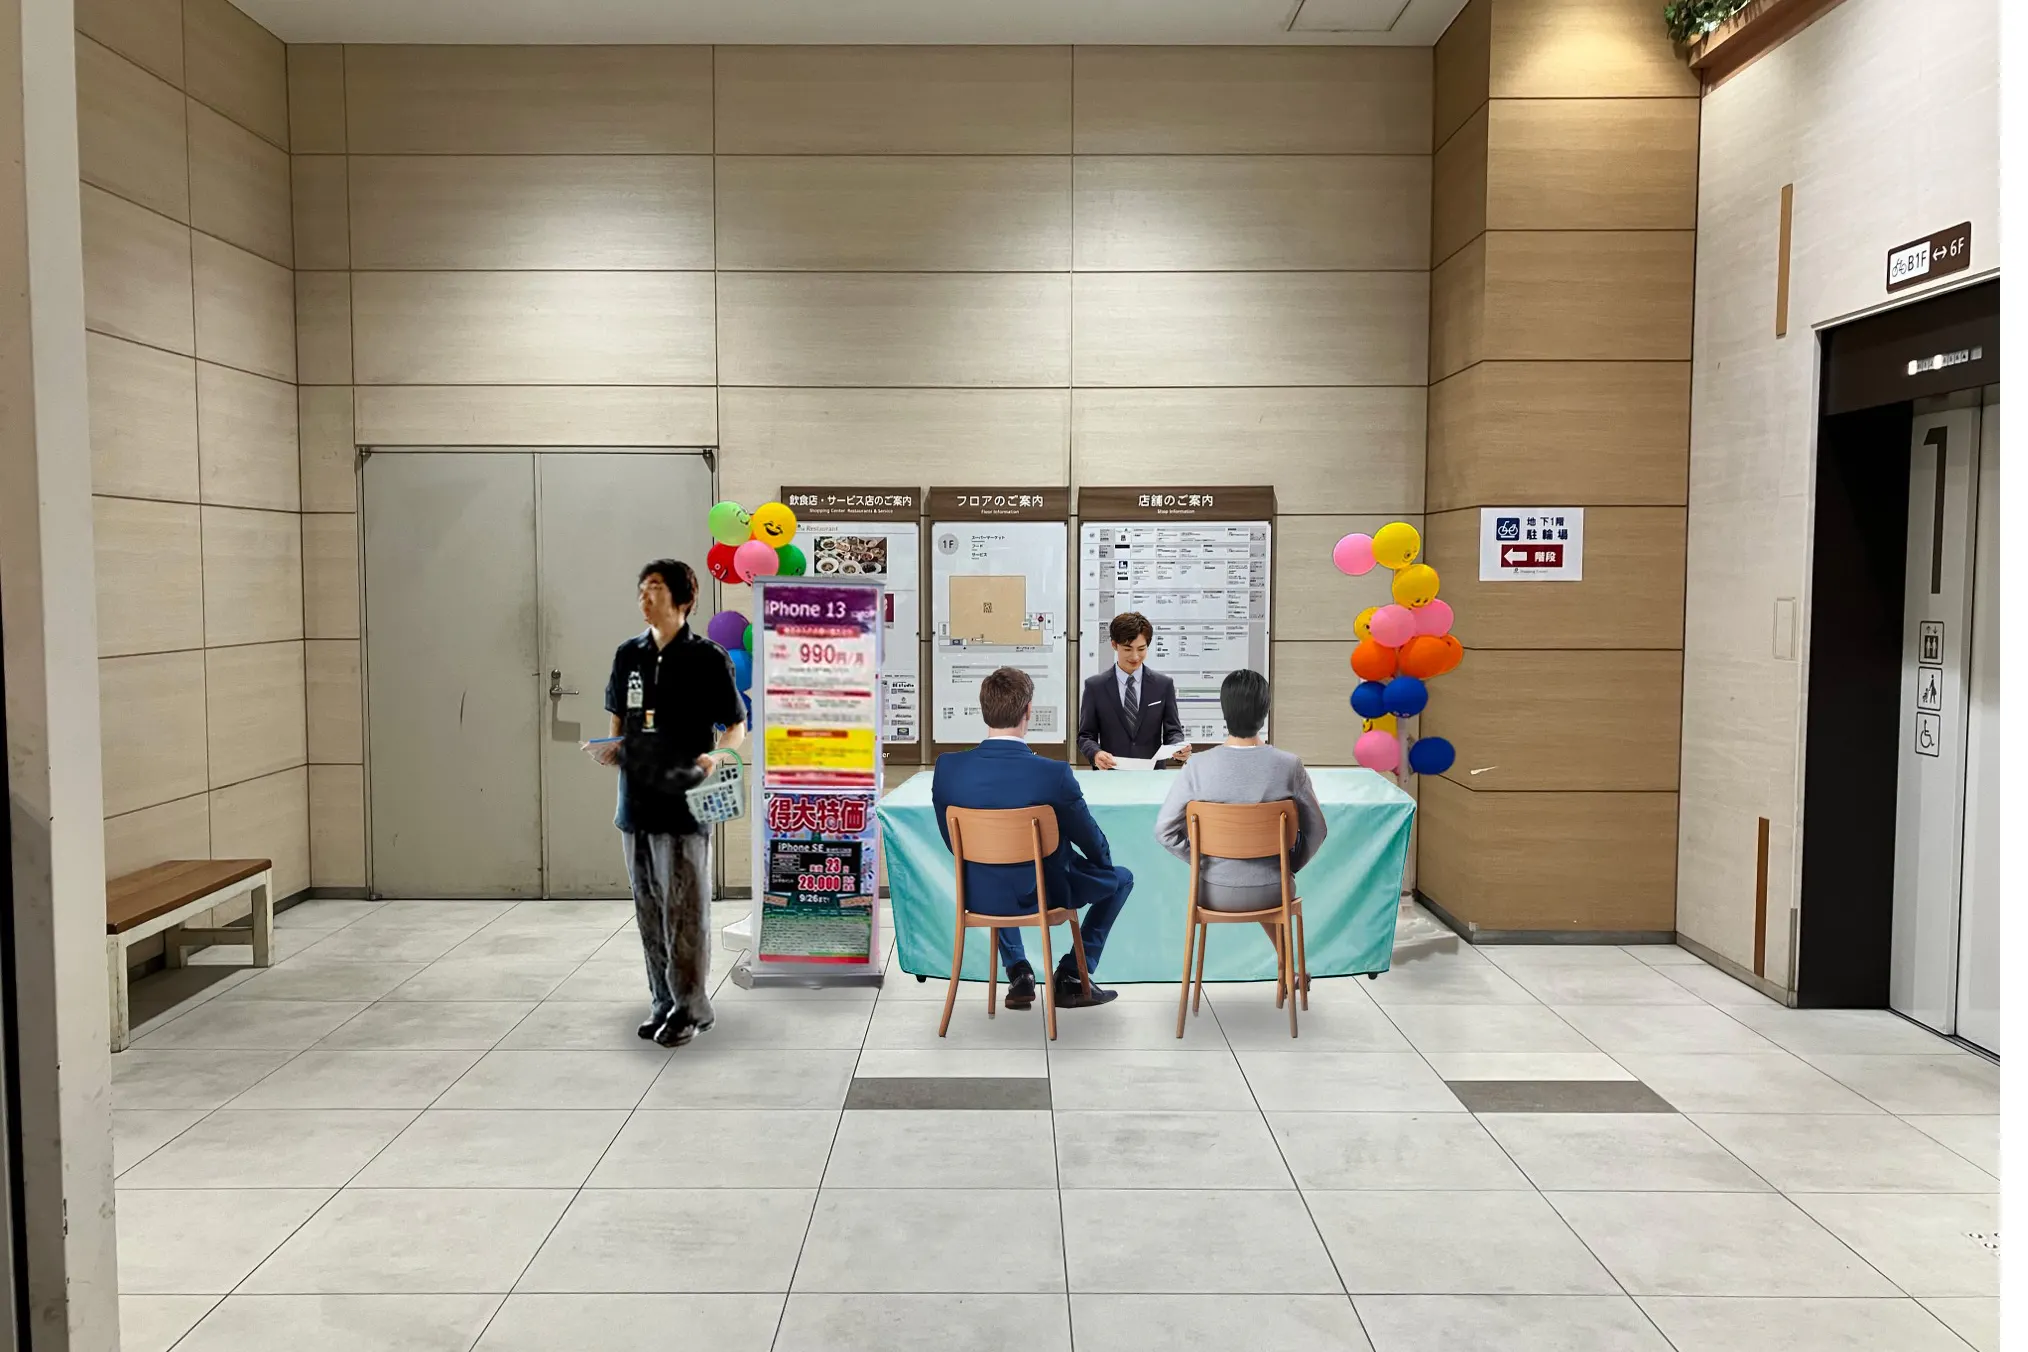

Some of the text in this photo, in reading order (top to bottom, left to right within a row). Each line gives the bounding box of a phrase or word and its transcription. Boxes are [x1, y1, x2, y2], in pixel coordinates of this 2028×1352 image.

[1908, 237, 1965, 271] B1F 6F
[789, 494, 912, 506] 飲食店・サービス店のご案内
[957, 495, 1044, 507] フロアのご案内
[1138, 494, 1214, 507] 店舗のご案内
[1923, 426, 1948, 594] 1
[1526, 529, 1568, 540] 駐輪場
[943, 540, 954, 548] 1F
[1534, 551, 1557, 562] 階段
[764, 600, 821, 617] iPhone
[826, 601, 847, 618] 13
[768, 796, 868, 832] 得大特価
[778, 843, 824, 852] iPhone SE
[825, 857, 842, 874] 23
[798, 874, 841, 891] 28,000
